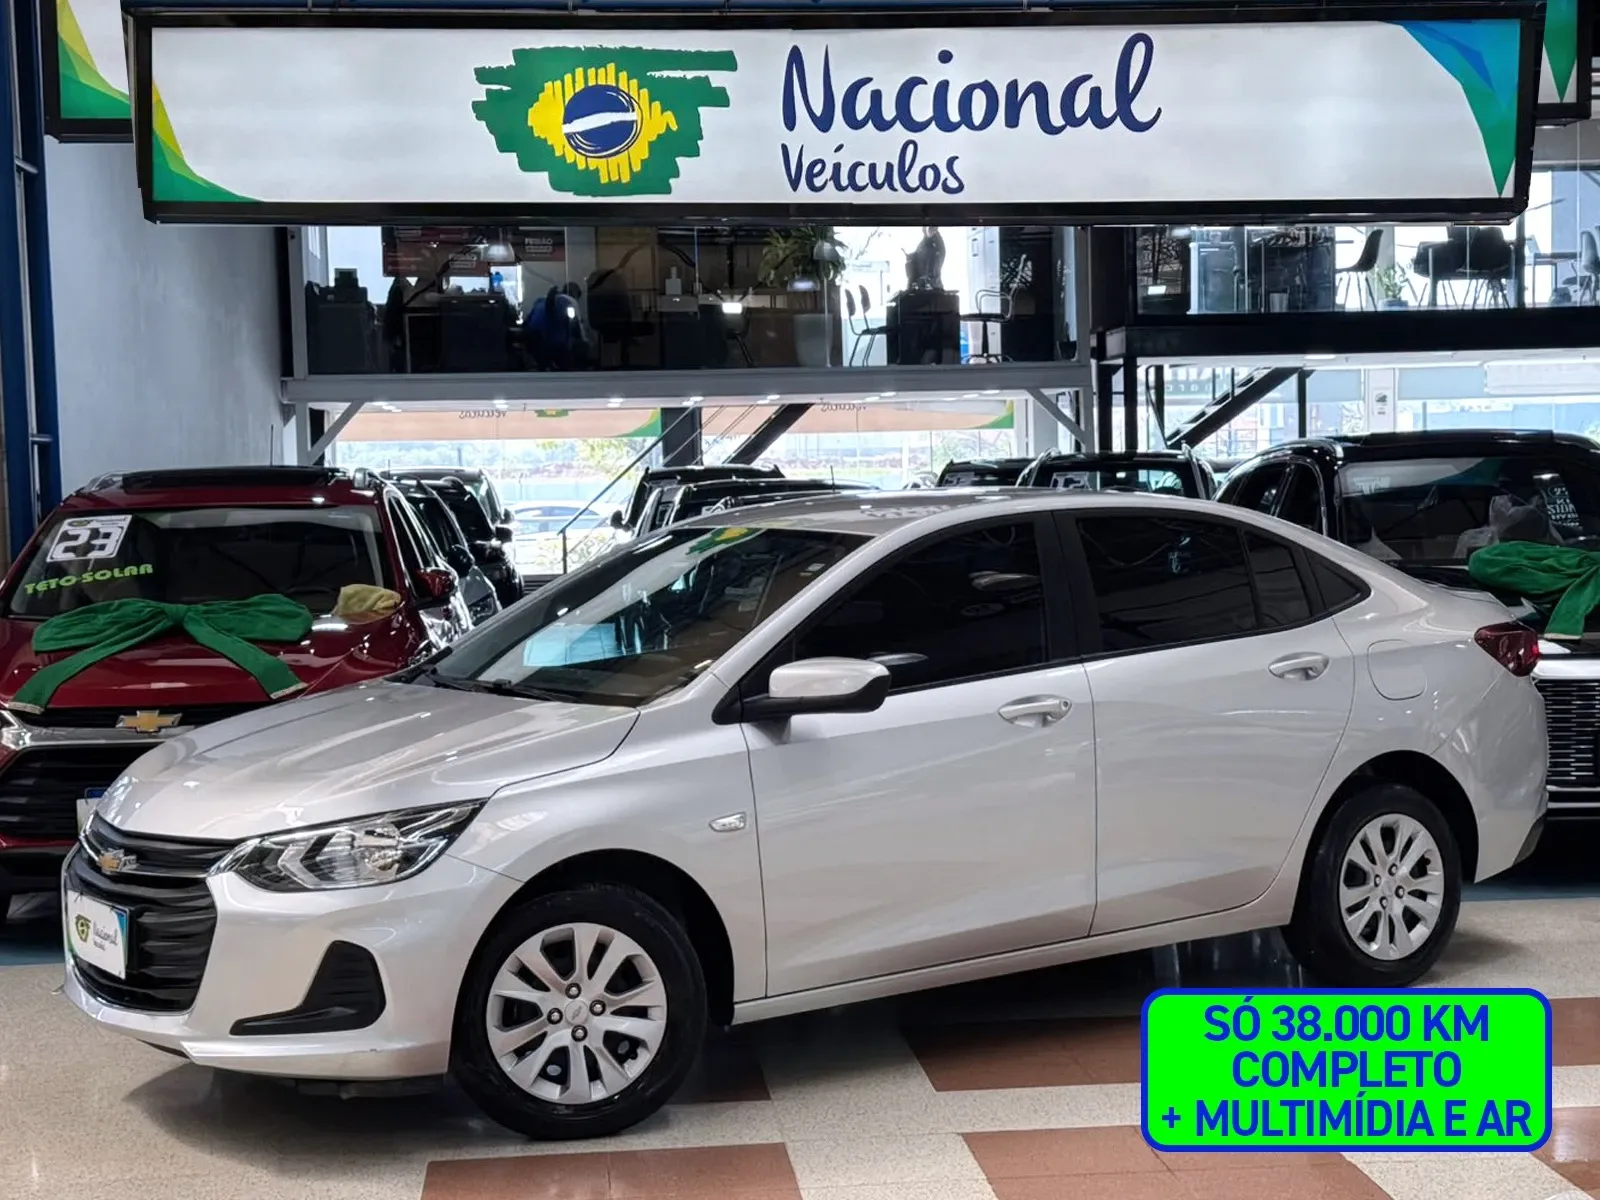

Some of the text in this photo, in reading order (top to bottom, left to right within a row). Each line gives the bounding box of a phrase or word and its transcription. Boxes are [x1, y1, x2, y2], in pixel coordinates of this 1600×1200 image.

[782, 32, 1162, 135] Nacional
[781, 139, 965, 194] Veículos
[52, 526, 122, 558] 23
